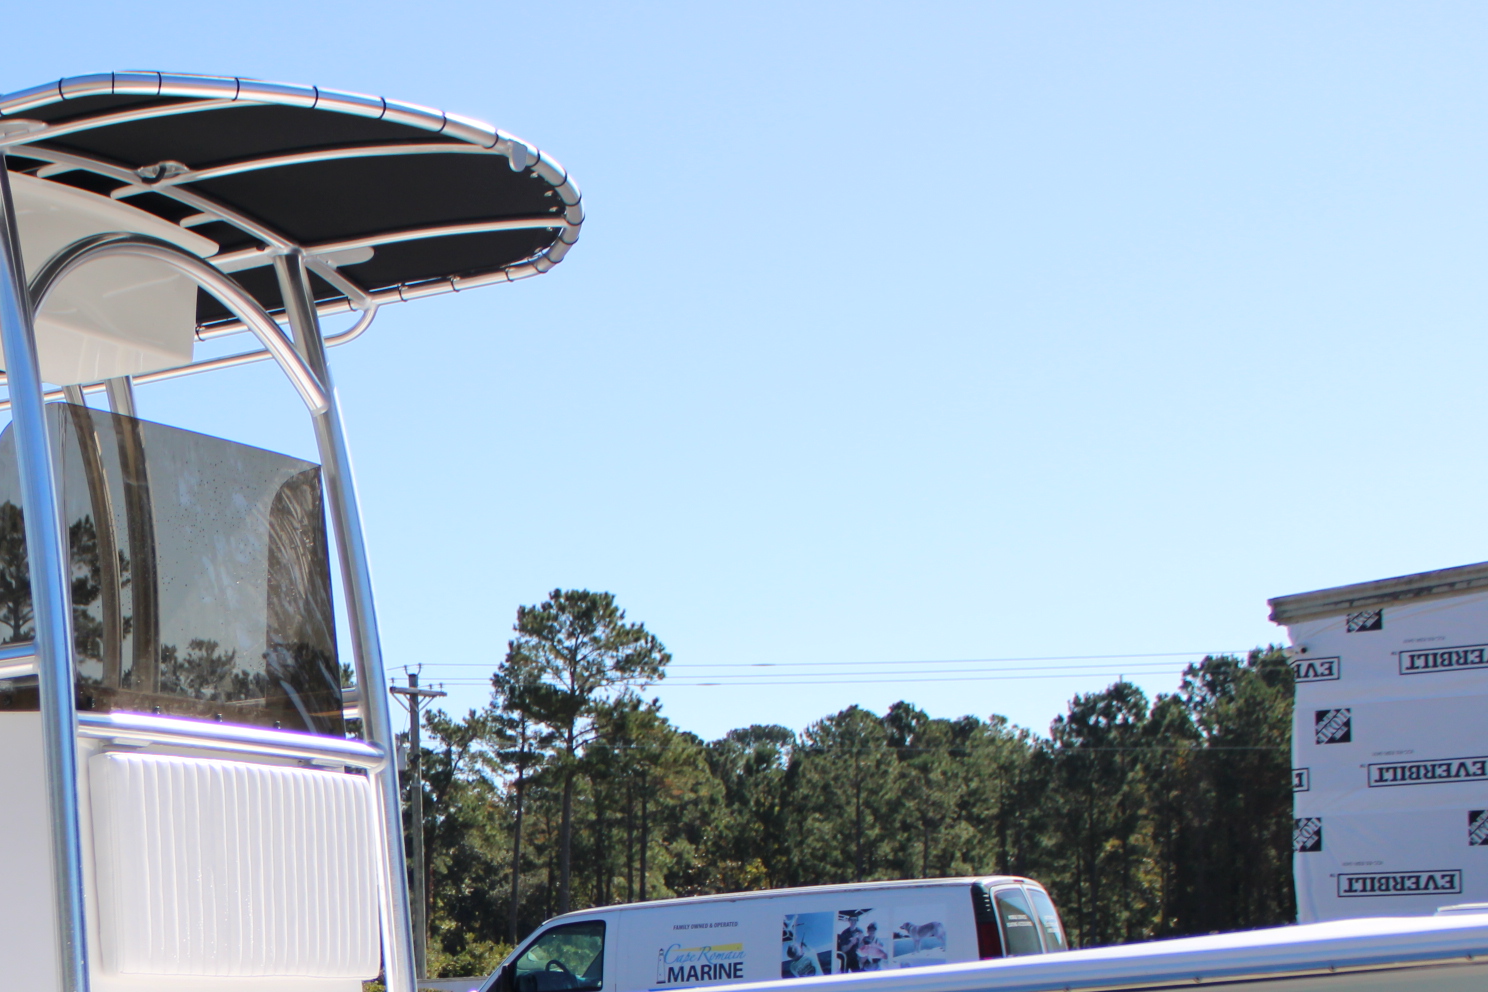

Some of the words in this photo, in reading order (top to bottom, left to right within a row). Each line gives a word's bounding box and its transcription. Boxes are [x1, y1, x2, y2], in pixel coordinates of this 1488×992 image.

[1405, 648, 1488, 671] ERBILT
[1374, 760, 1488, 783] EVERBILT
[1343, 874, 1457, 893] EVERBILT
[697, 946, 746, 965] Romain
[667, 962, 743, 983] MARINE
